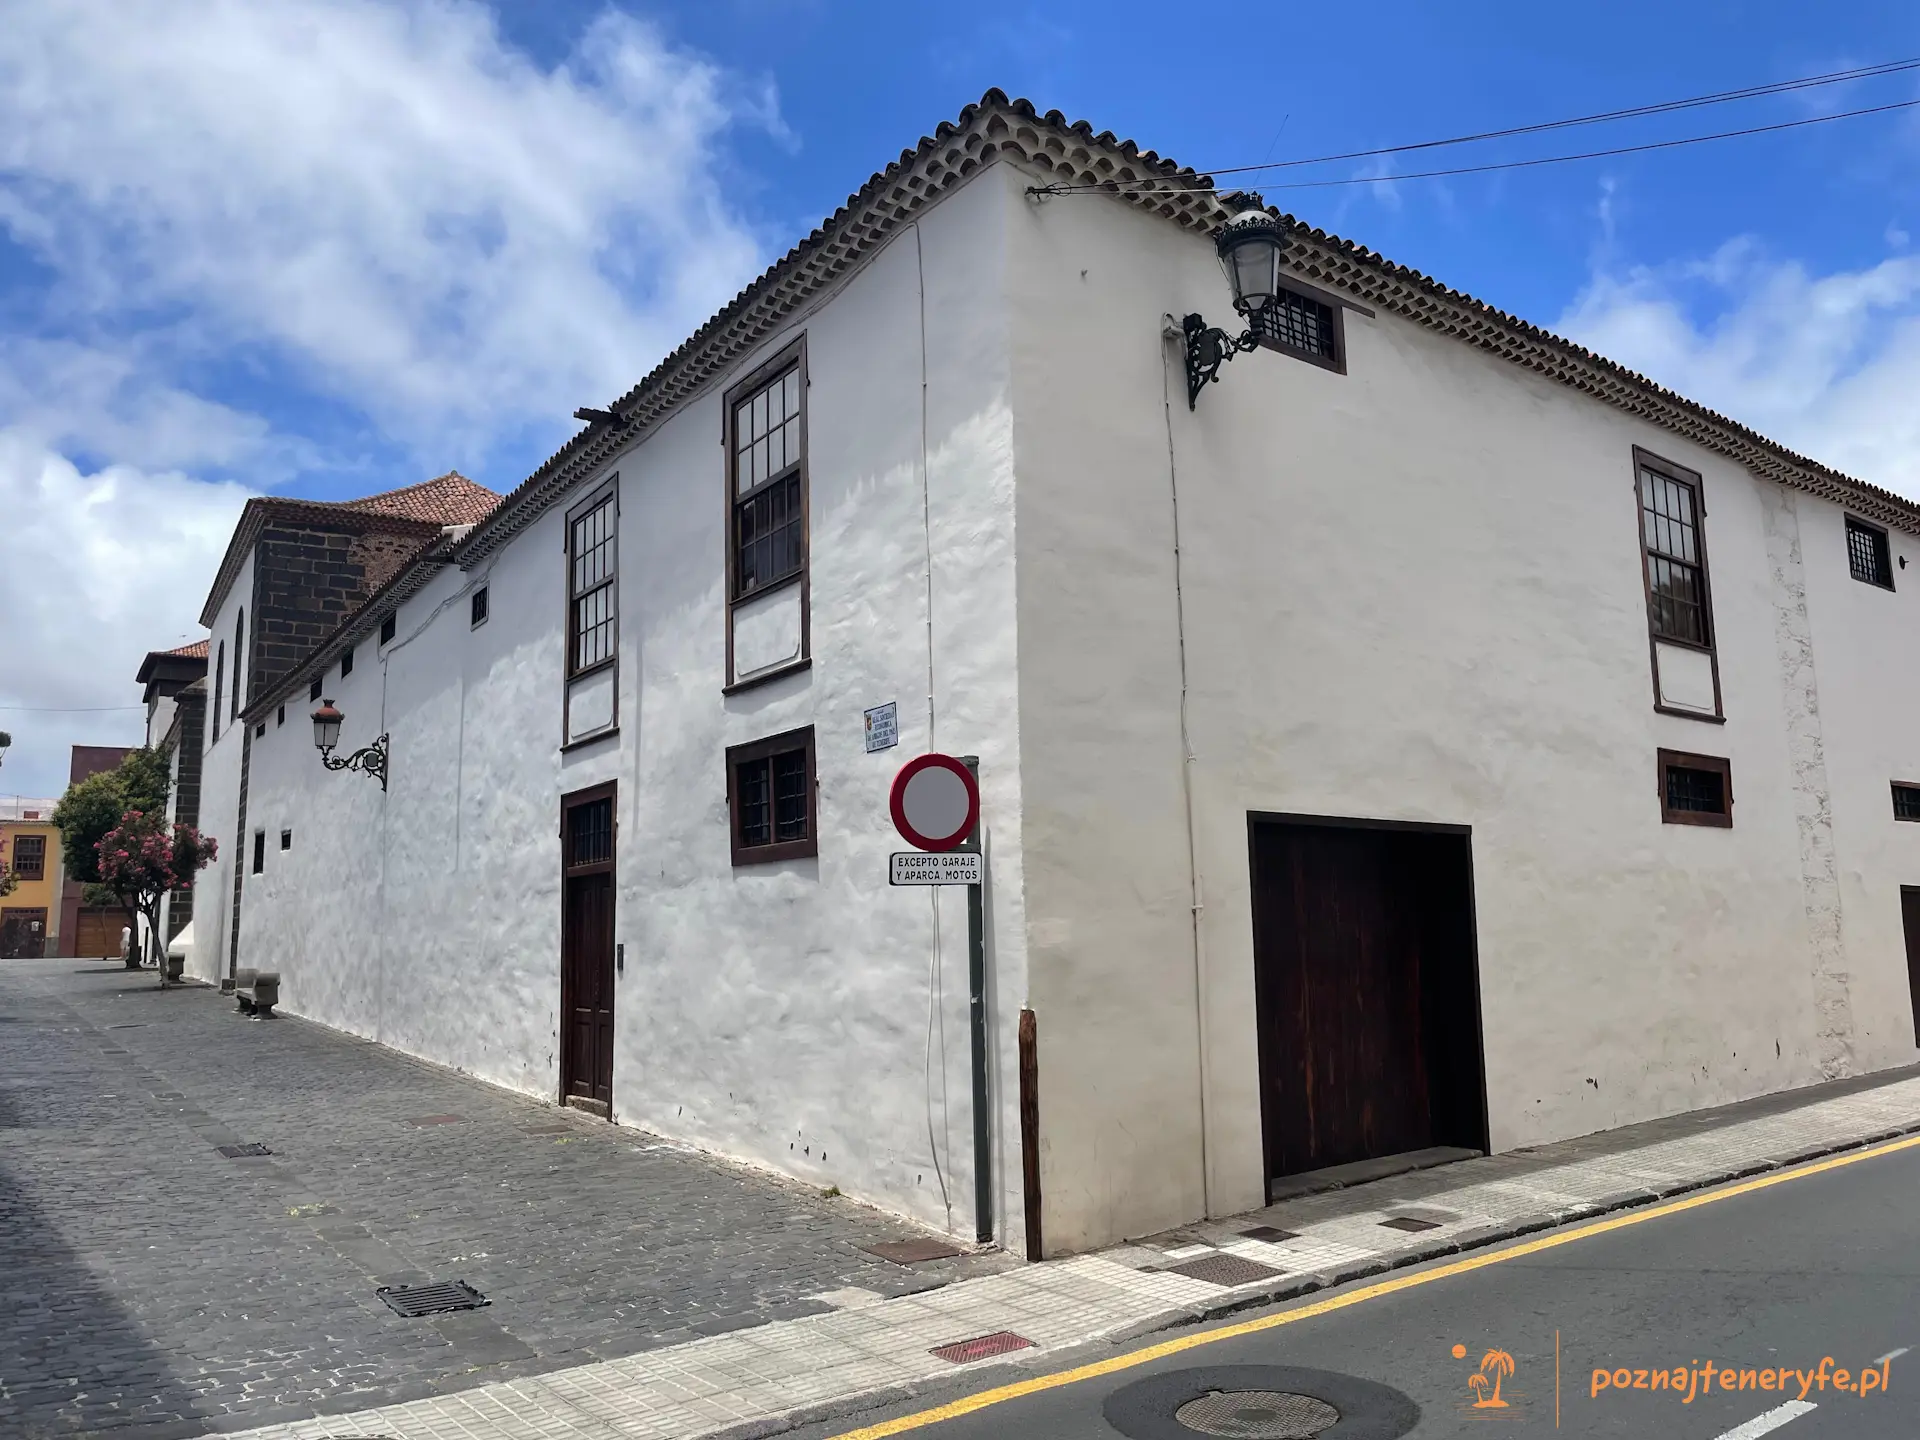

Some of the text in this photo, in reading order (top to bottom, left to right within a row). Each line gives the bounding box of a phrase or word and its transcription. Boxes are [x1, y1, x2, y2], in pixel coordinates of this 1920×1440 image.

[898, 857, 975, 867] EXCEPTO GARAJE
[896, 870, 978, 880] Y APARCA. MOTOS
